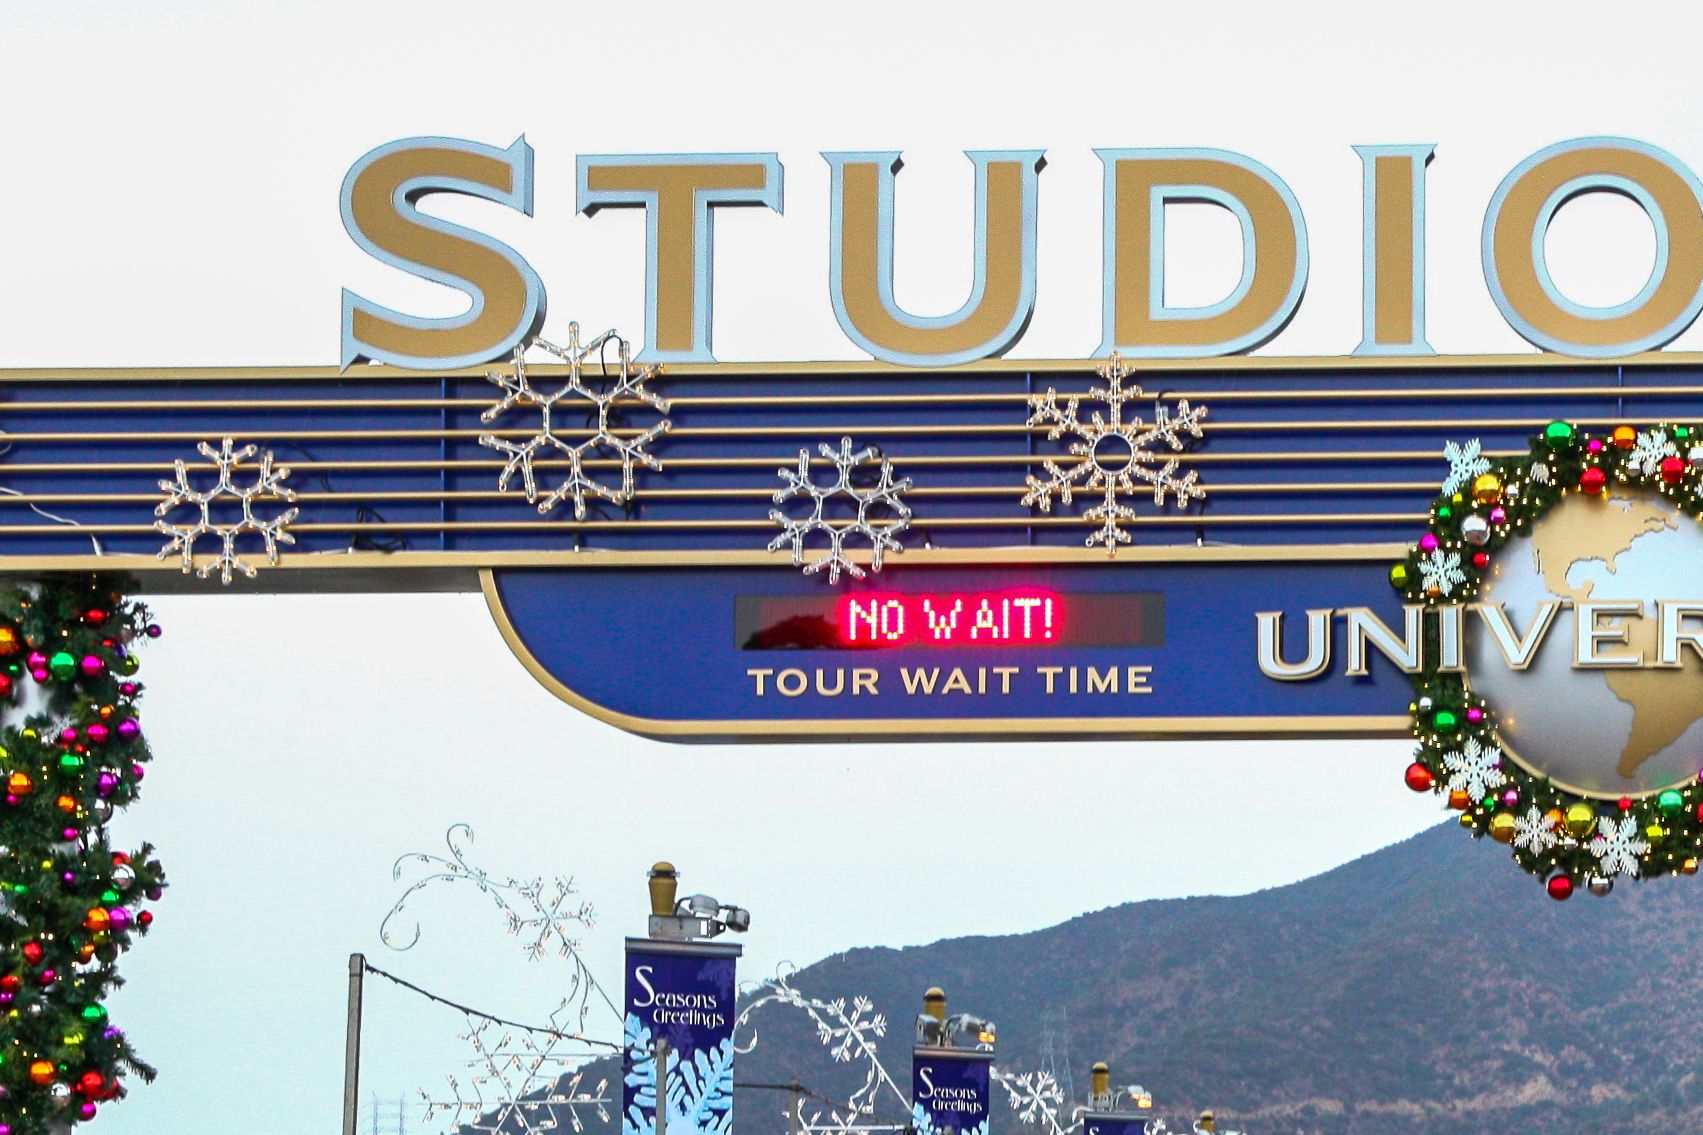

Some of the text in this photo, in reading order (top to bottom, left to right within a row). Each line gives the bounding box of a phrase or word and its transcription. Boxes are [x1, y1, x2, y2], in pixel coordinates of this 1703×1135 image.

[848, 596, 1053, 641] NO WAIT!
[747, 665, 1153, 697] TOUR WAIT TIME
[634, 965, 717, 1009] Seasons
[653, 1008, 725, 1029] Greetings
[919, 1066, 977, 1099] Seasons
[932, 1099, 982, 1114] Greetings
